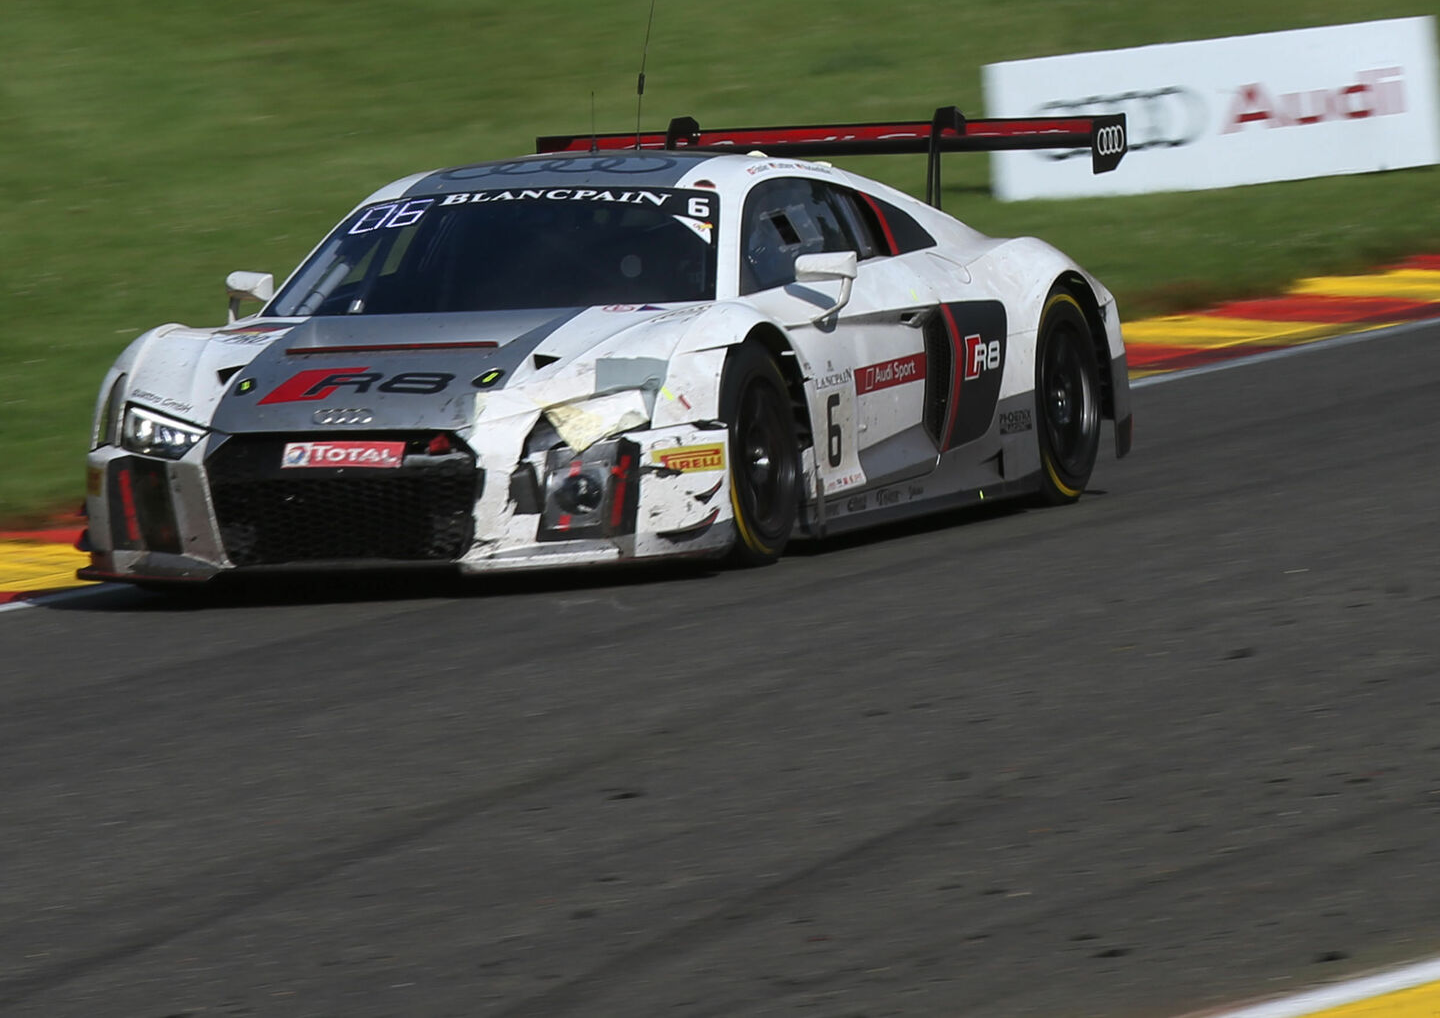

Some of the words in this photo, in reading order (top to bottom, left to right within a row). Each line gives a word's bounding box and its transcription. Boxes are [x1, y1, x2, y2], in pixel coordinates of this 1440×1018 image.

[1218, 66, 1407, 135] Audi
[438, 189, 672, 207] BLANCPAIN
[688, 197, 710, 218] 6
[972, 337, 1000, 374] R8
[300, 370, 456, 397] R8
[875, 363, 894, 384] Audi
[893, 360, 916, 381] Sport
[827, 392, 842, 468] 6
[313, 444, 397, 464] TOTAL
